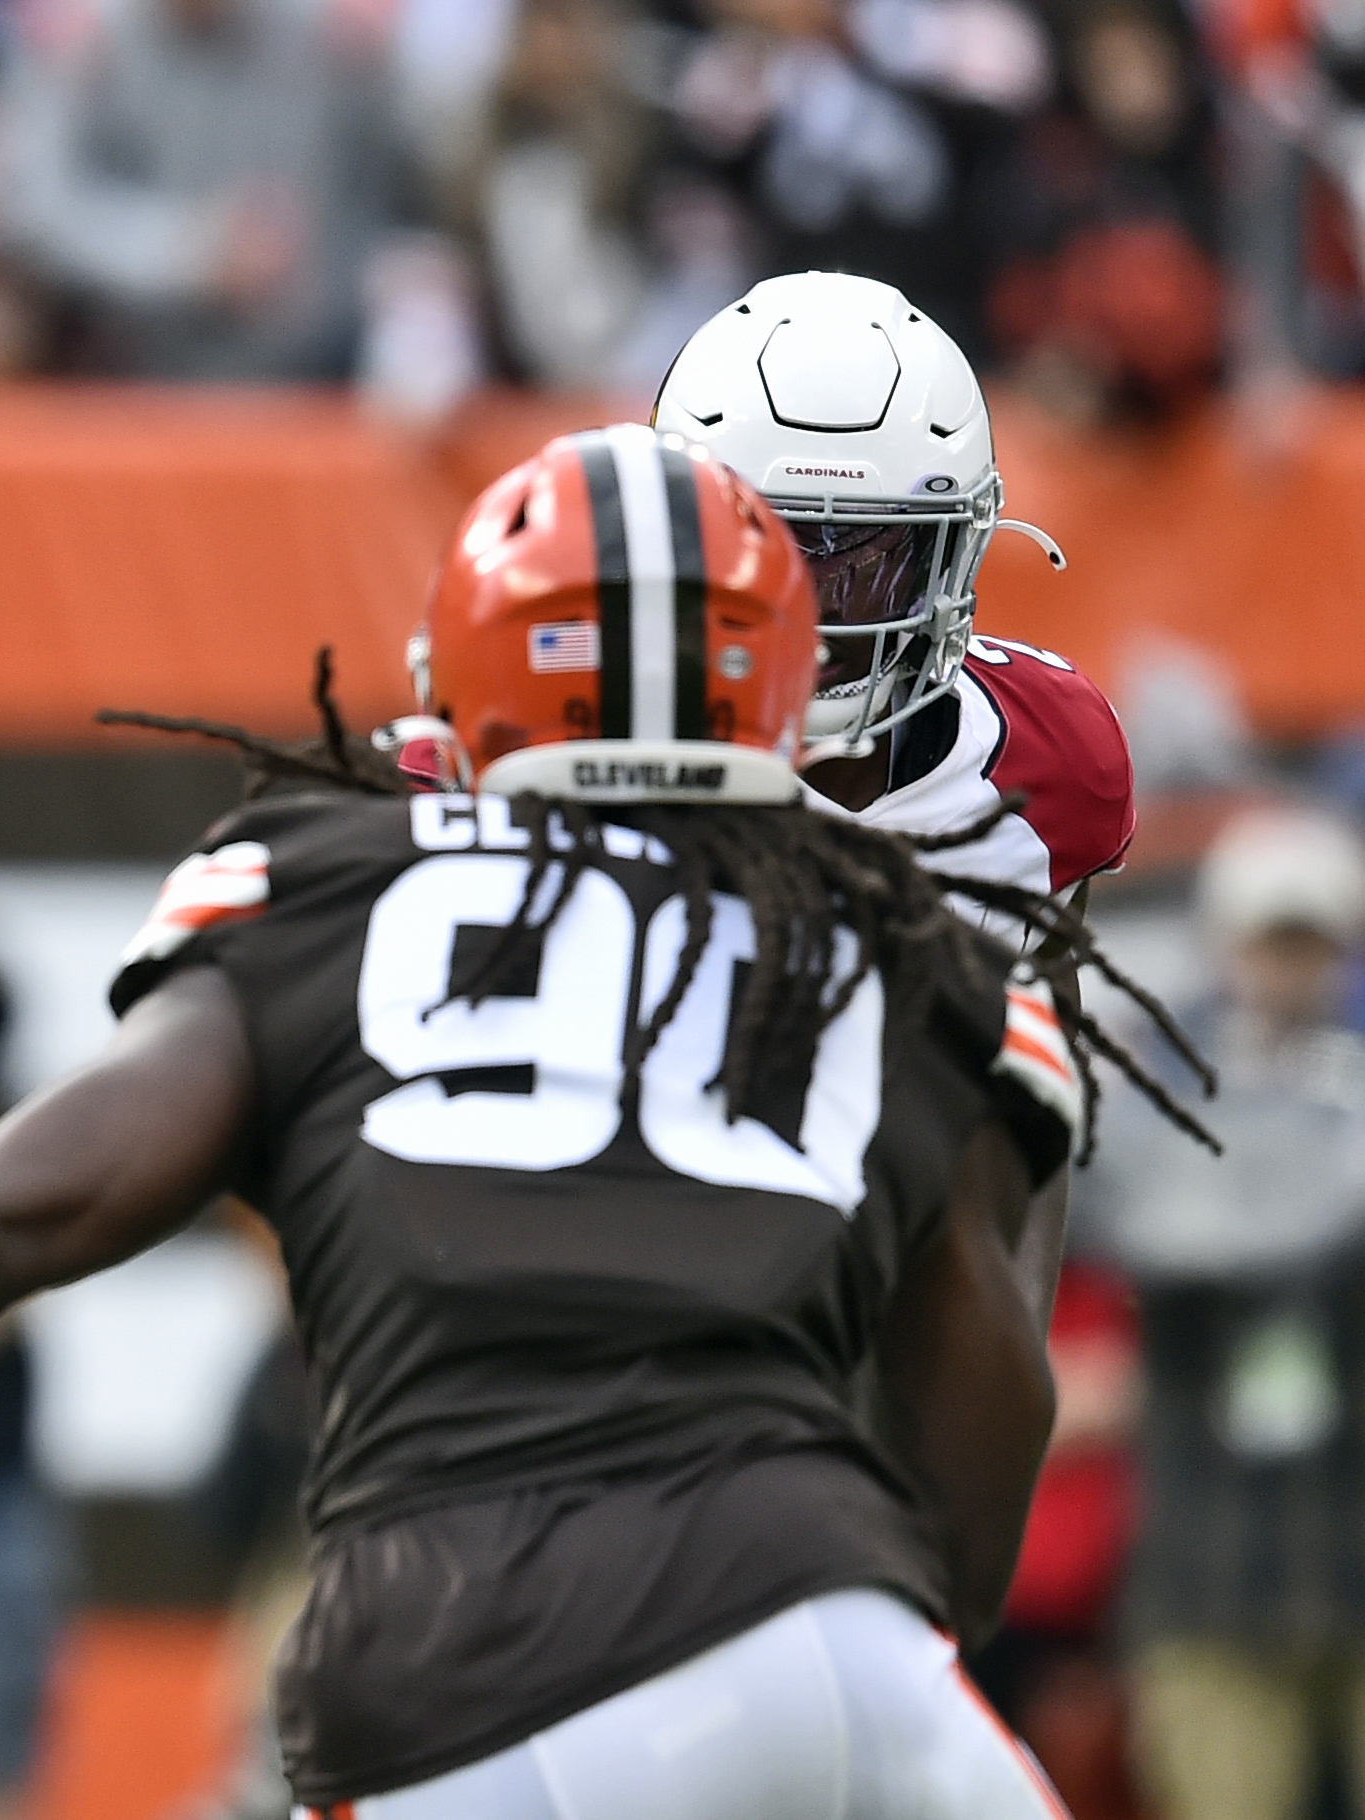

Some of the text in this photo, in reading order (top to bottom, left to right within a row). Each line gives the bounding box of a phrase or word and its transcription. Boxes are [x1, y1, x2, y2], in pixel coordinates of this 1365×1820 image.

[785, 467, 865, 479] CARDINALS
[573, 761, 726, 788] CLEVELAND
[357, 852, 886, 1220] 90
